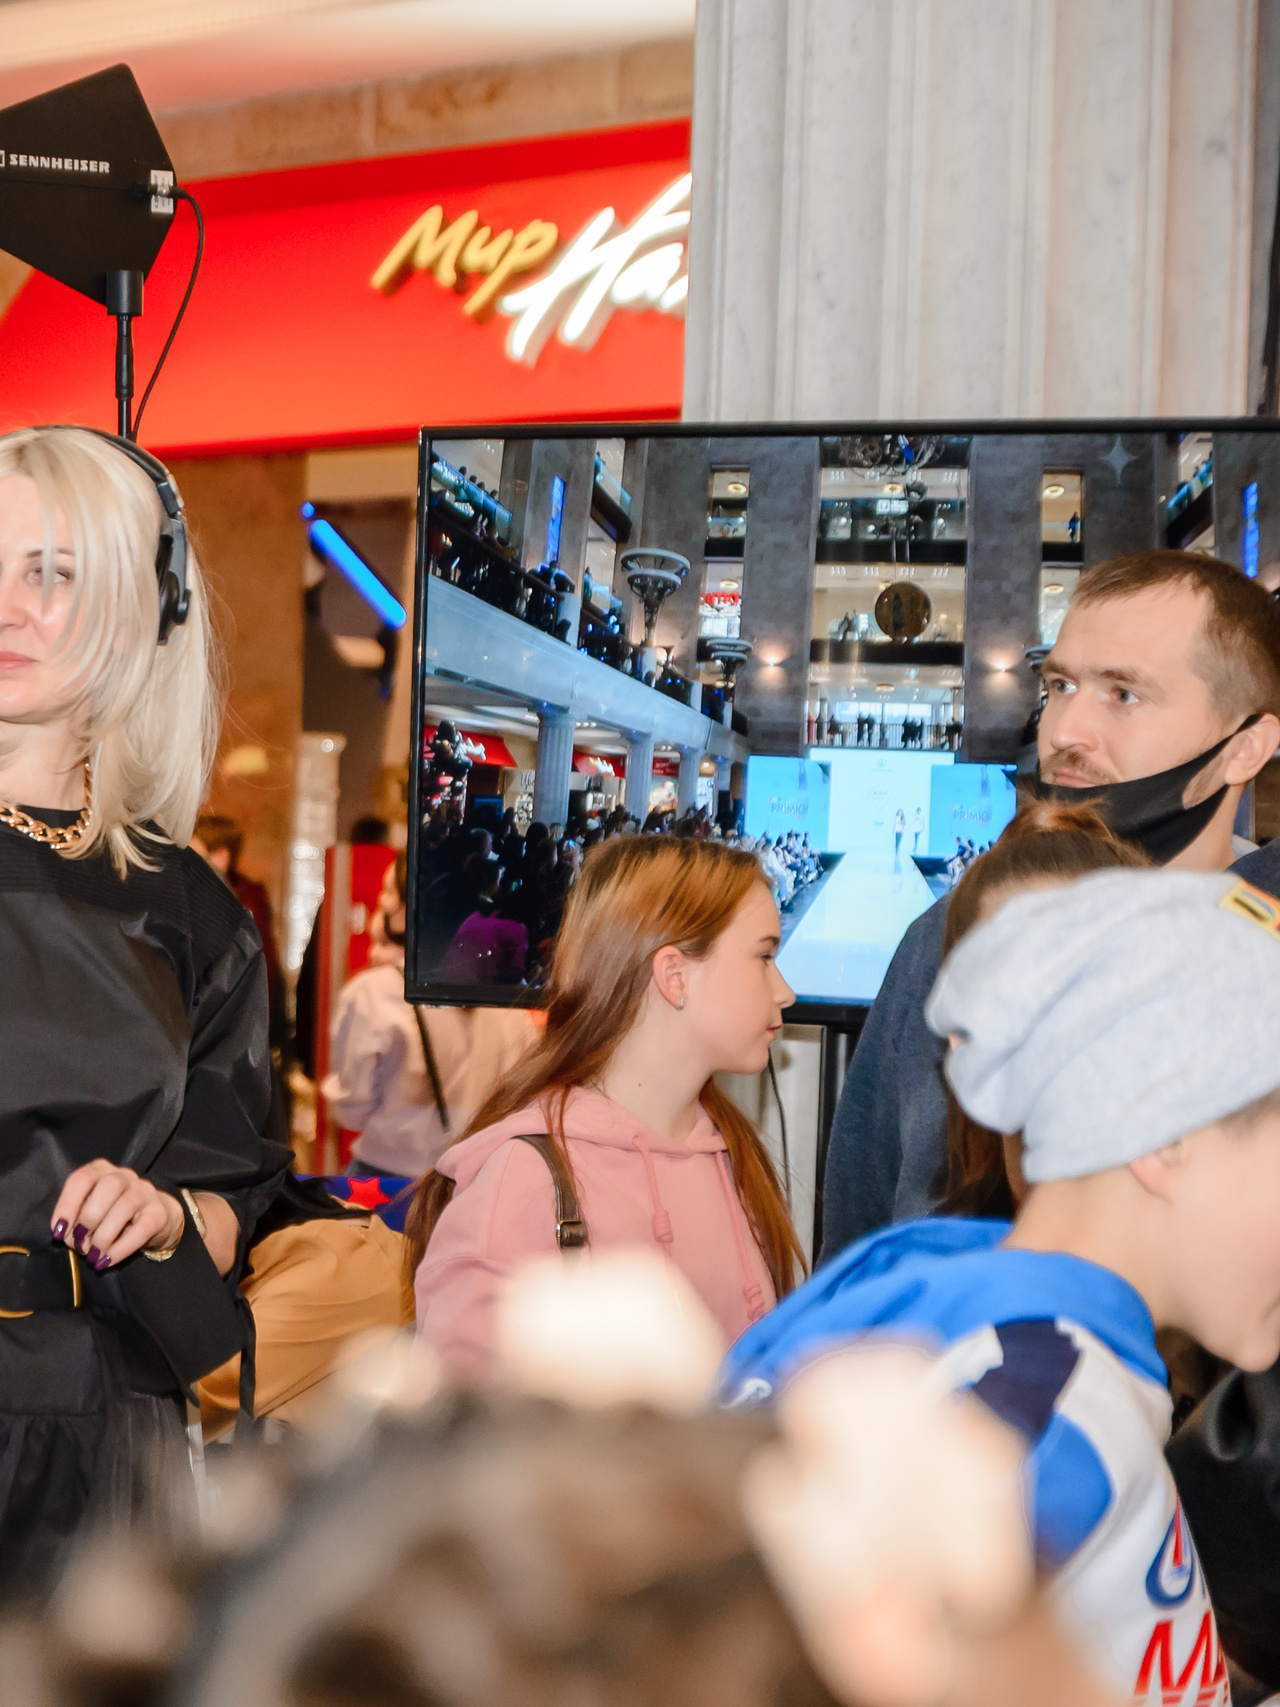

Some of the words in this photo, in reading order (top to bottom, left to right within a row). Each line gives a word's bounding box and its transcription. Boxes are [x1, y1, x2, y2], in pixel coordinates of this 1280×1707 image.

[9, 153, 110, 174] SENNHEISER
[370, 204, 559, 316] Мир
[501, 171, 693, 363] На
